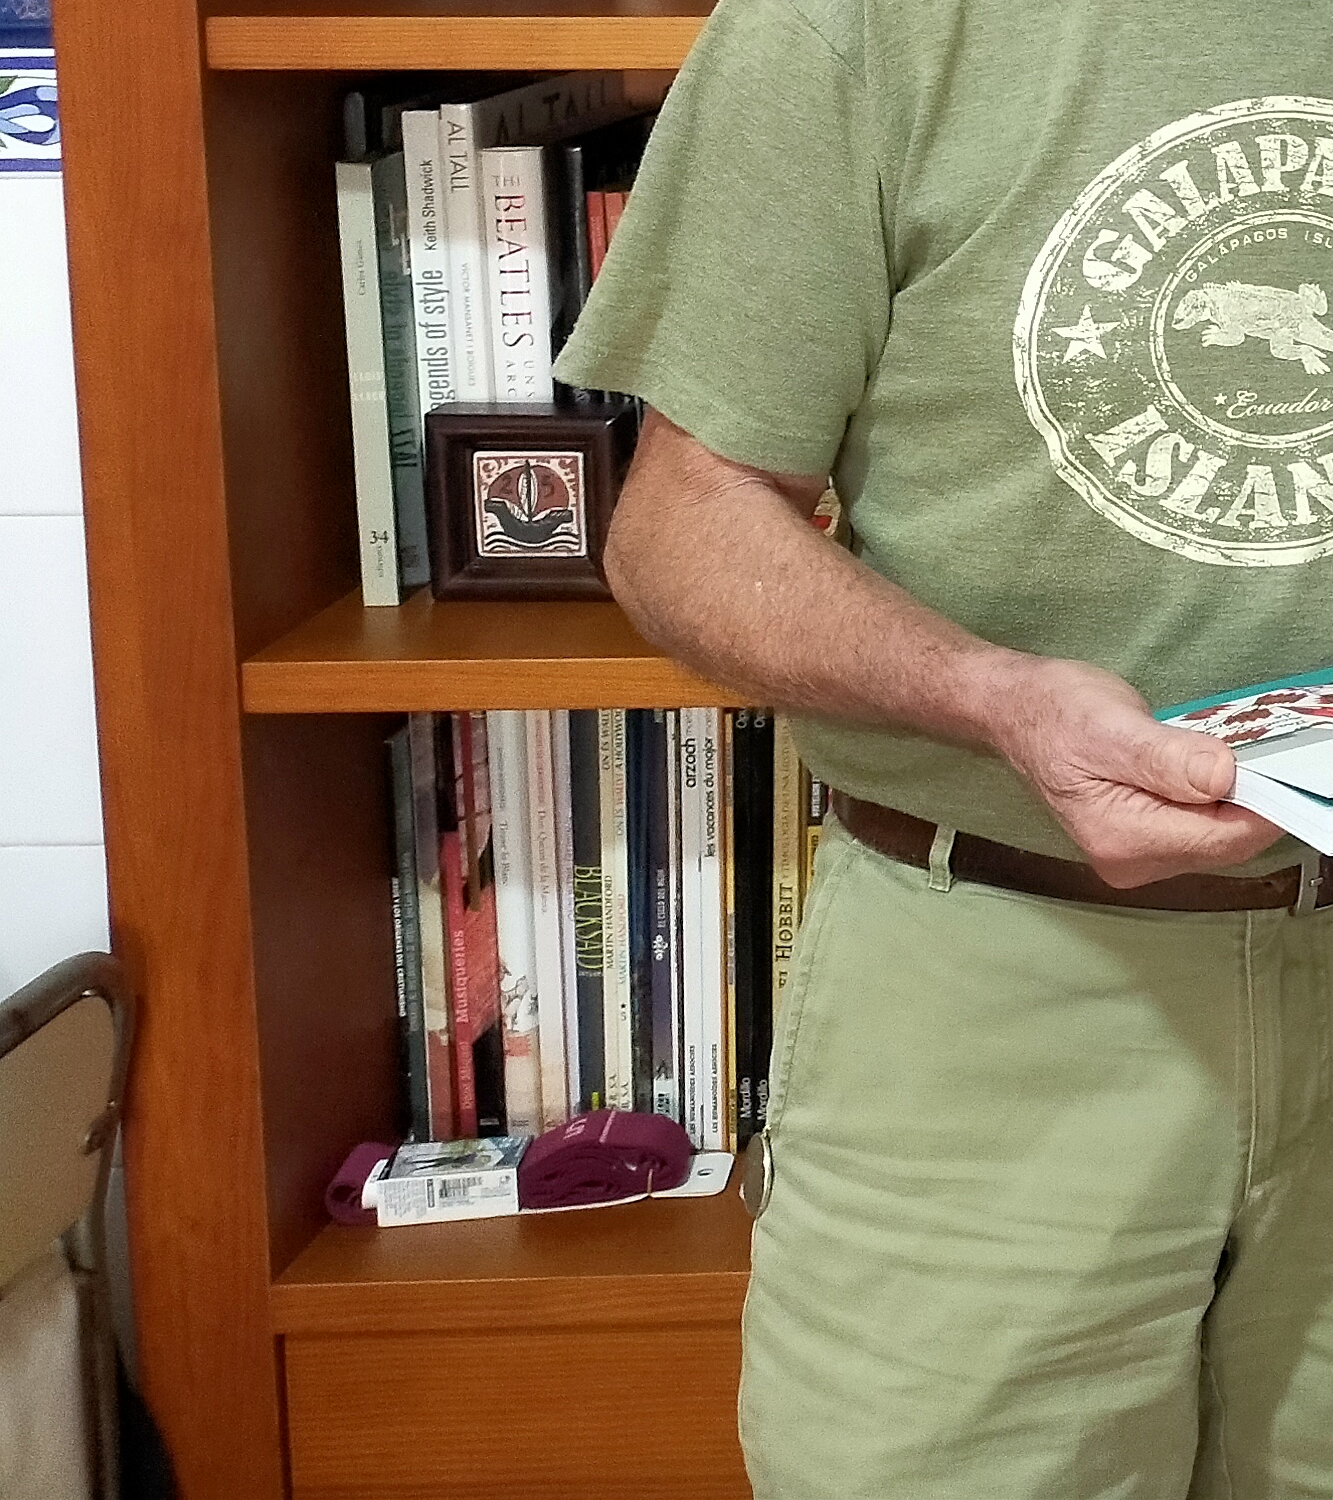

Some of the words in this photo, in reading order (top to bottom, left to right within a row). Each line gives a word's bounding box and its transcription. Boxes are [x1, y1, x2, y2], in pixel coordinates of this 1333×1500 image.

[446, 120, 465, 146] AL
[421, 159, 436, 220] Shadwick
[450, 151, 471, 192] TALL
[425, 219, 438, 253] Keith
[492, 193, 535, 348] BEATLES
[1226, 389, 1333, 419] Ecuador
[682, 737, 697, 788] arzach
[703, 737, 717, 770] major
[703, 773, 714, 788] du
[706, 790, 716, 842] vacances
[704, 843, 716, 857] les
[574, 865, 603, 970] BLACKSAD
[604, 875, 614, 930] HANDFORD
[616, 893, 627, 948] HANDFORD
[604, 932, 615, 970] MARTIN
[618, 949, 627, 985] MARTIN
[452, 929, 468, 1023] Musiquetes
[739, 1077, 752, 1118] Mordillo
[756, 1079, 768, 1120] Mordillo
